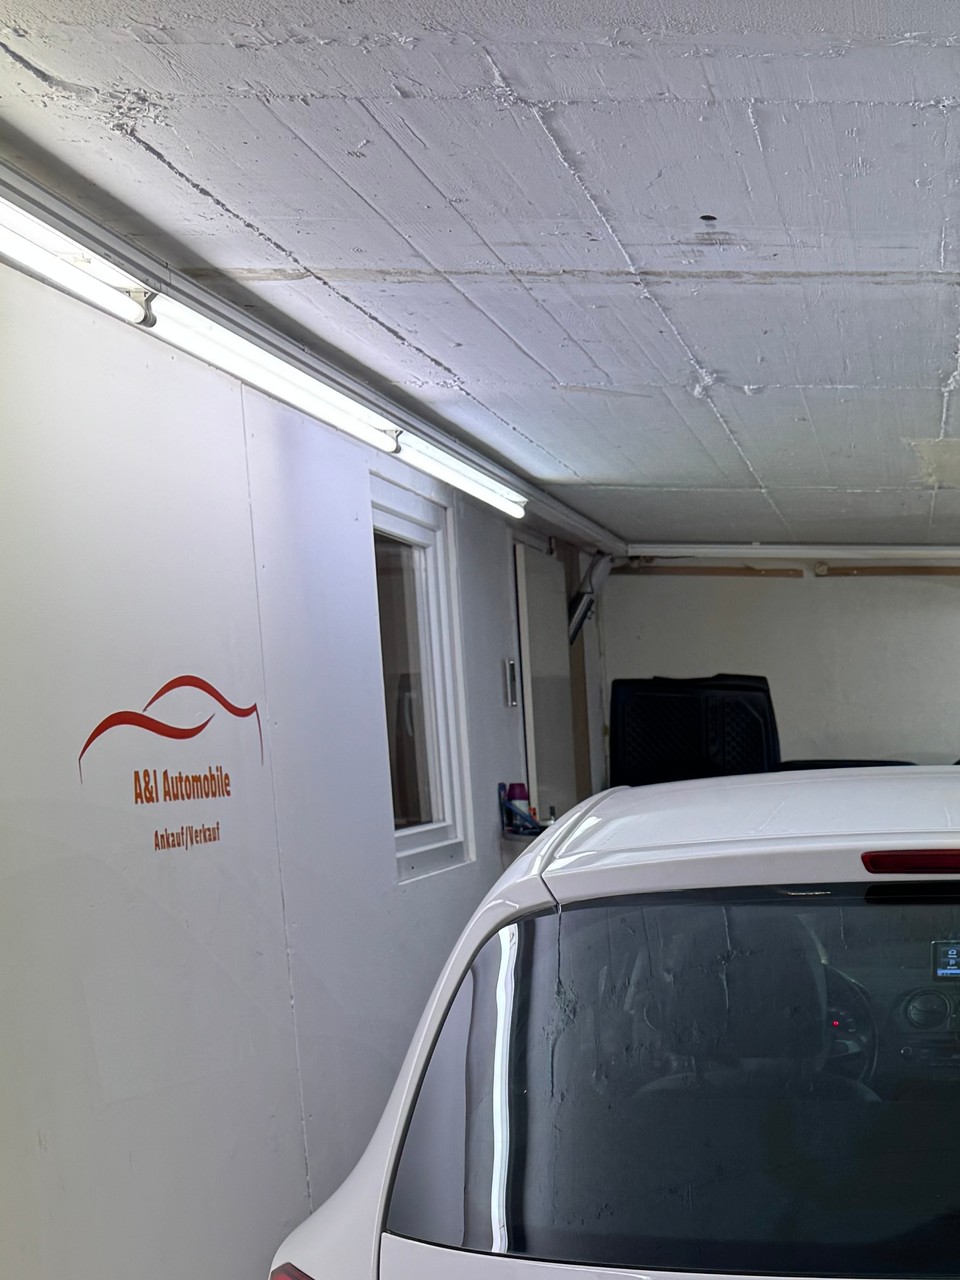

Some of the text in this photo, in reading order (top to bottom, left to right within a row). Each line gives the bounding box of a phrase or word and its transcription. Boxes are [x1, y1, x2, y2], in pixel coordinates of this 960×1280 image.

[133, 765, 231, 805] A&I Automobile
[153, 821, 221, 851] Ankauf/Verkauf
